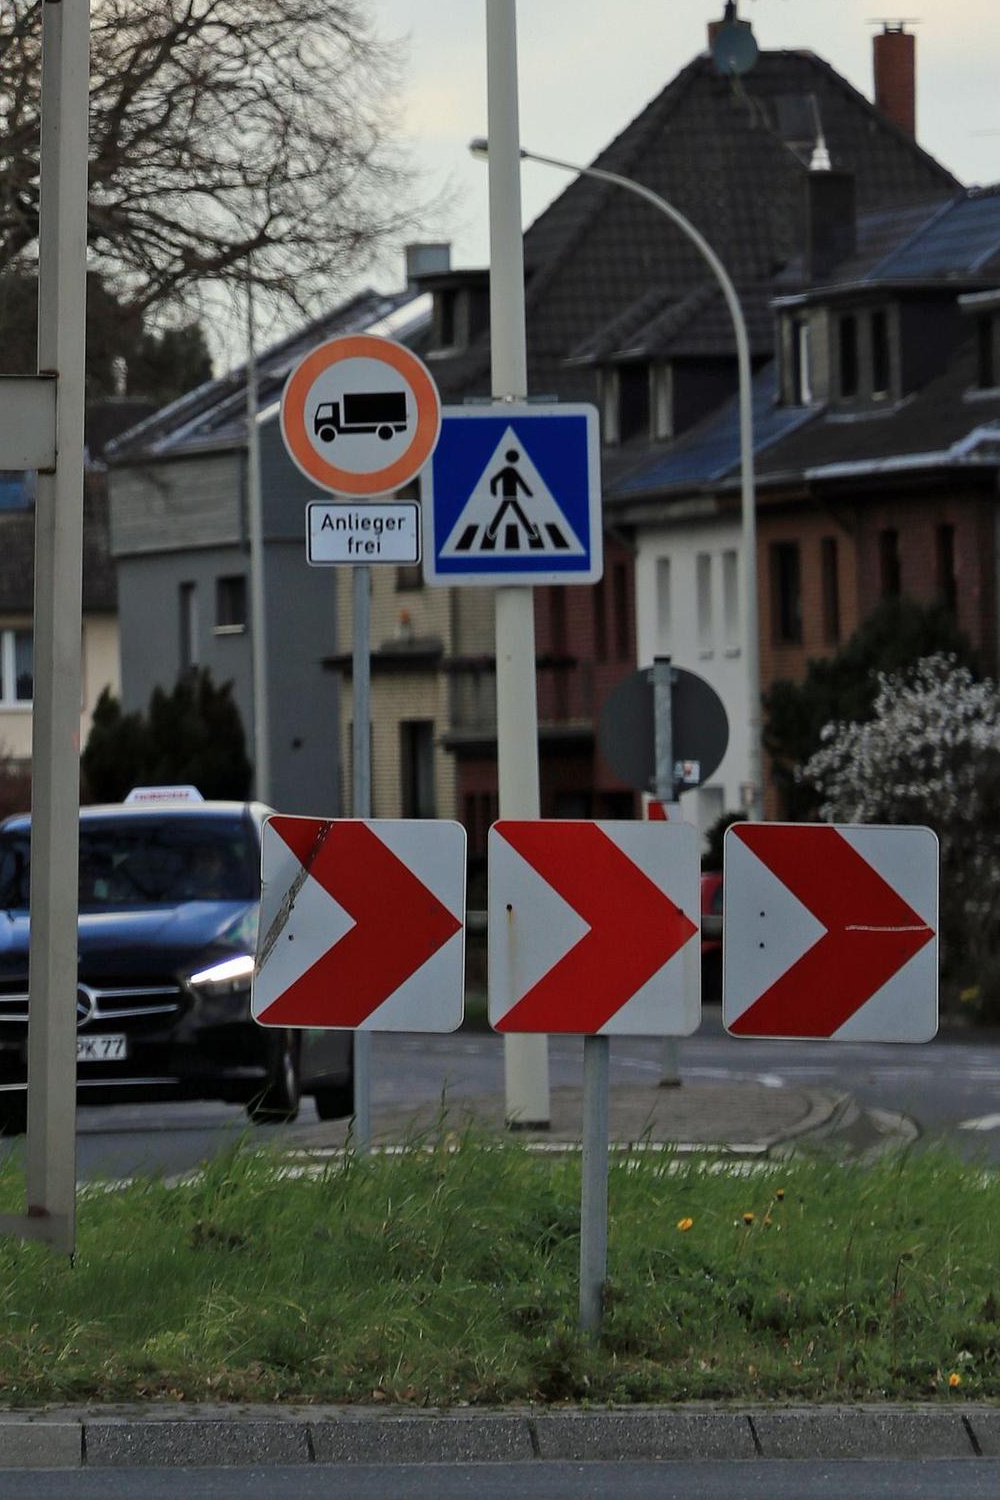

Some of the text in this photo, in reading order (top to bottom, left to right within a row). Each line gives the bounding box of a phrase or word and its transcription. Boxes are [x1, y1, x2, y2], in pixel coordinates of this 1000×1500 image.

[321, 512, 406, 535] Anlieger
[348, 535, 381, 554] frei
[101, 1039, 124, 1057] 77
